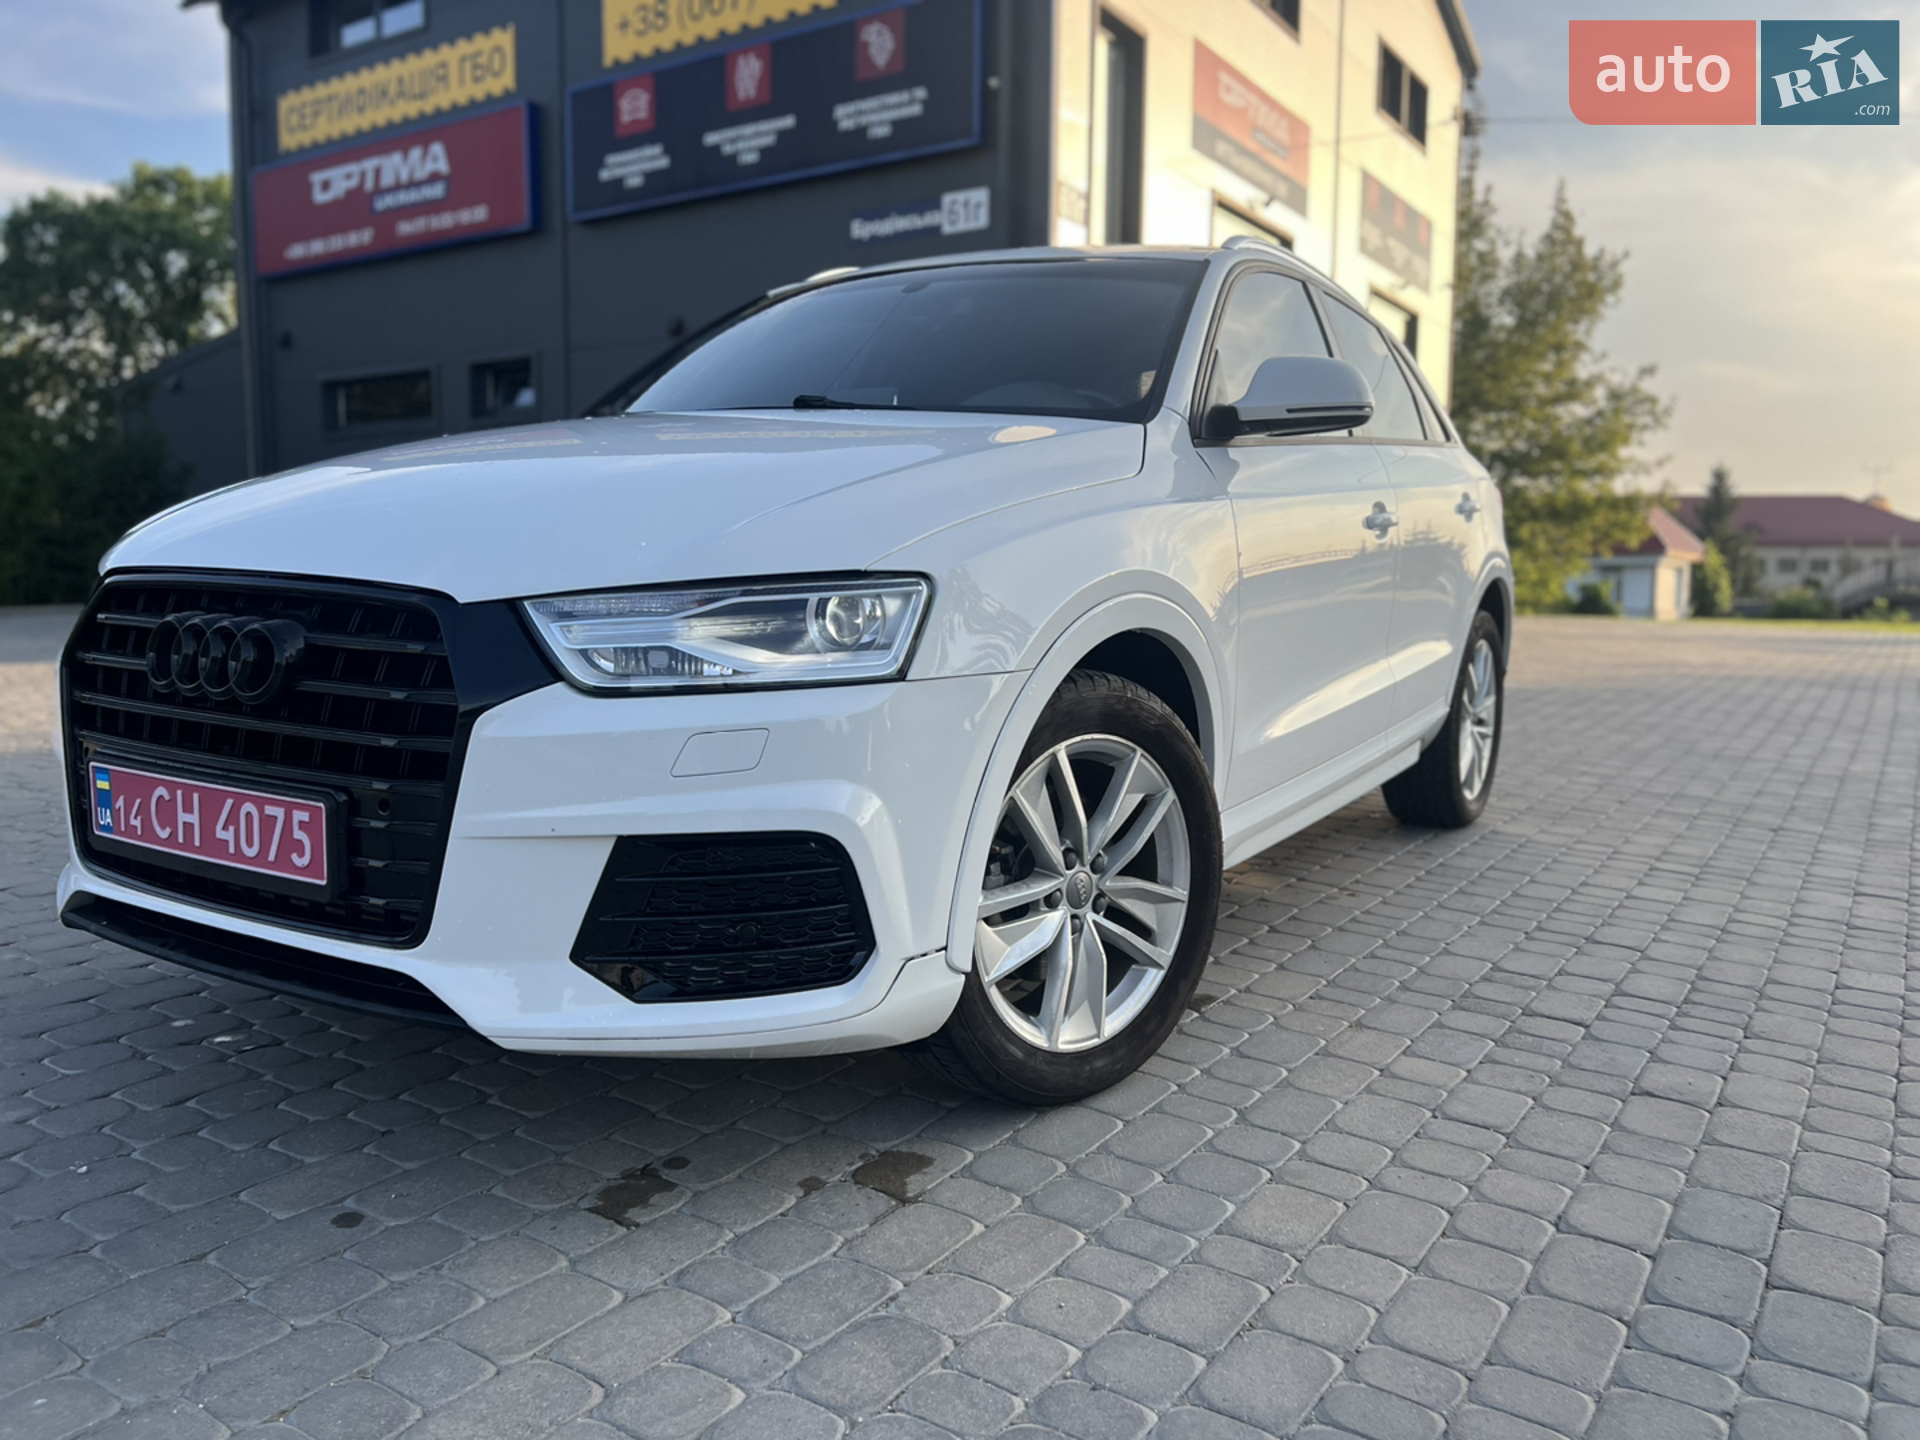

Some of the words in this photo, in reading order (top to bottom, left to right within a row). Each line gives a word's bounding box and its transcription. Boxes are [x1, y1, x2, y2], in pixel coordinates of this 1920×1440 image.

[284, 60, 450, 136] СЕРТИФІКАЦІЯ
[457, 44, 508, 89] ГБО
[308, 140, 450, 205] OPTIMA
[97, 807, 113, 827] UA
[115, 795, 142, 835] 14
[151, 786, 200, 847] CH
[215, 798, 312, 868] 4075
